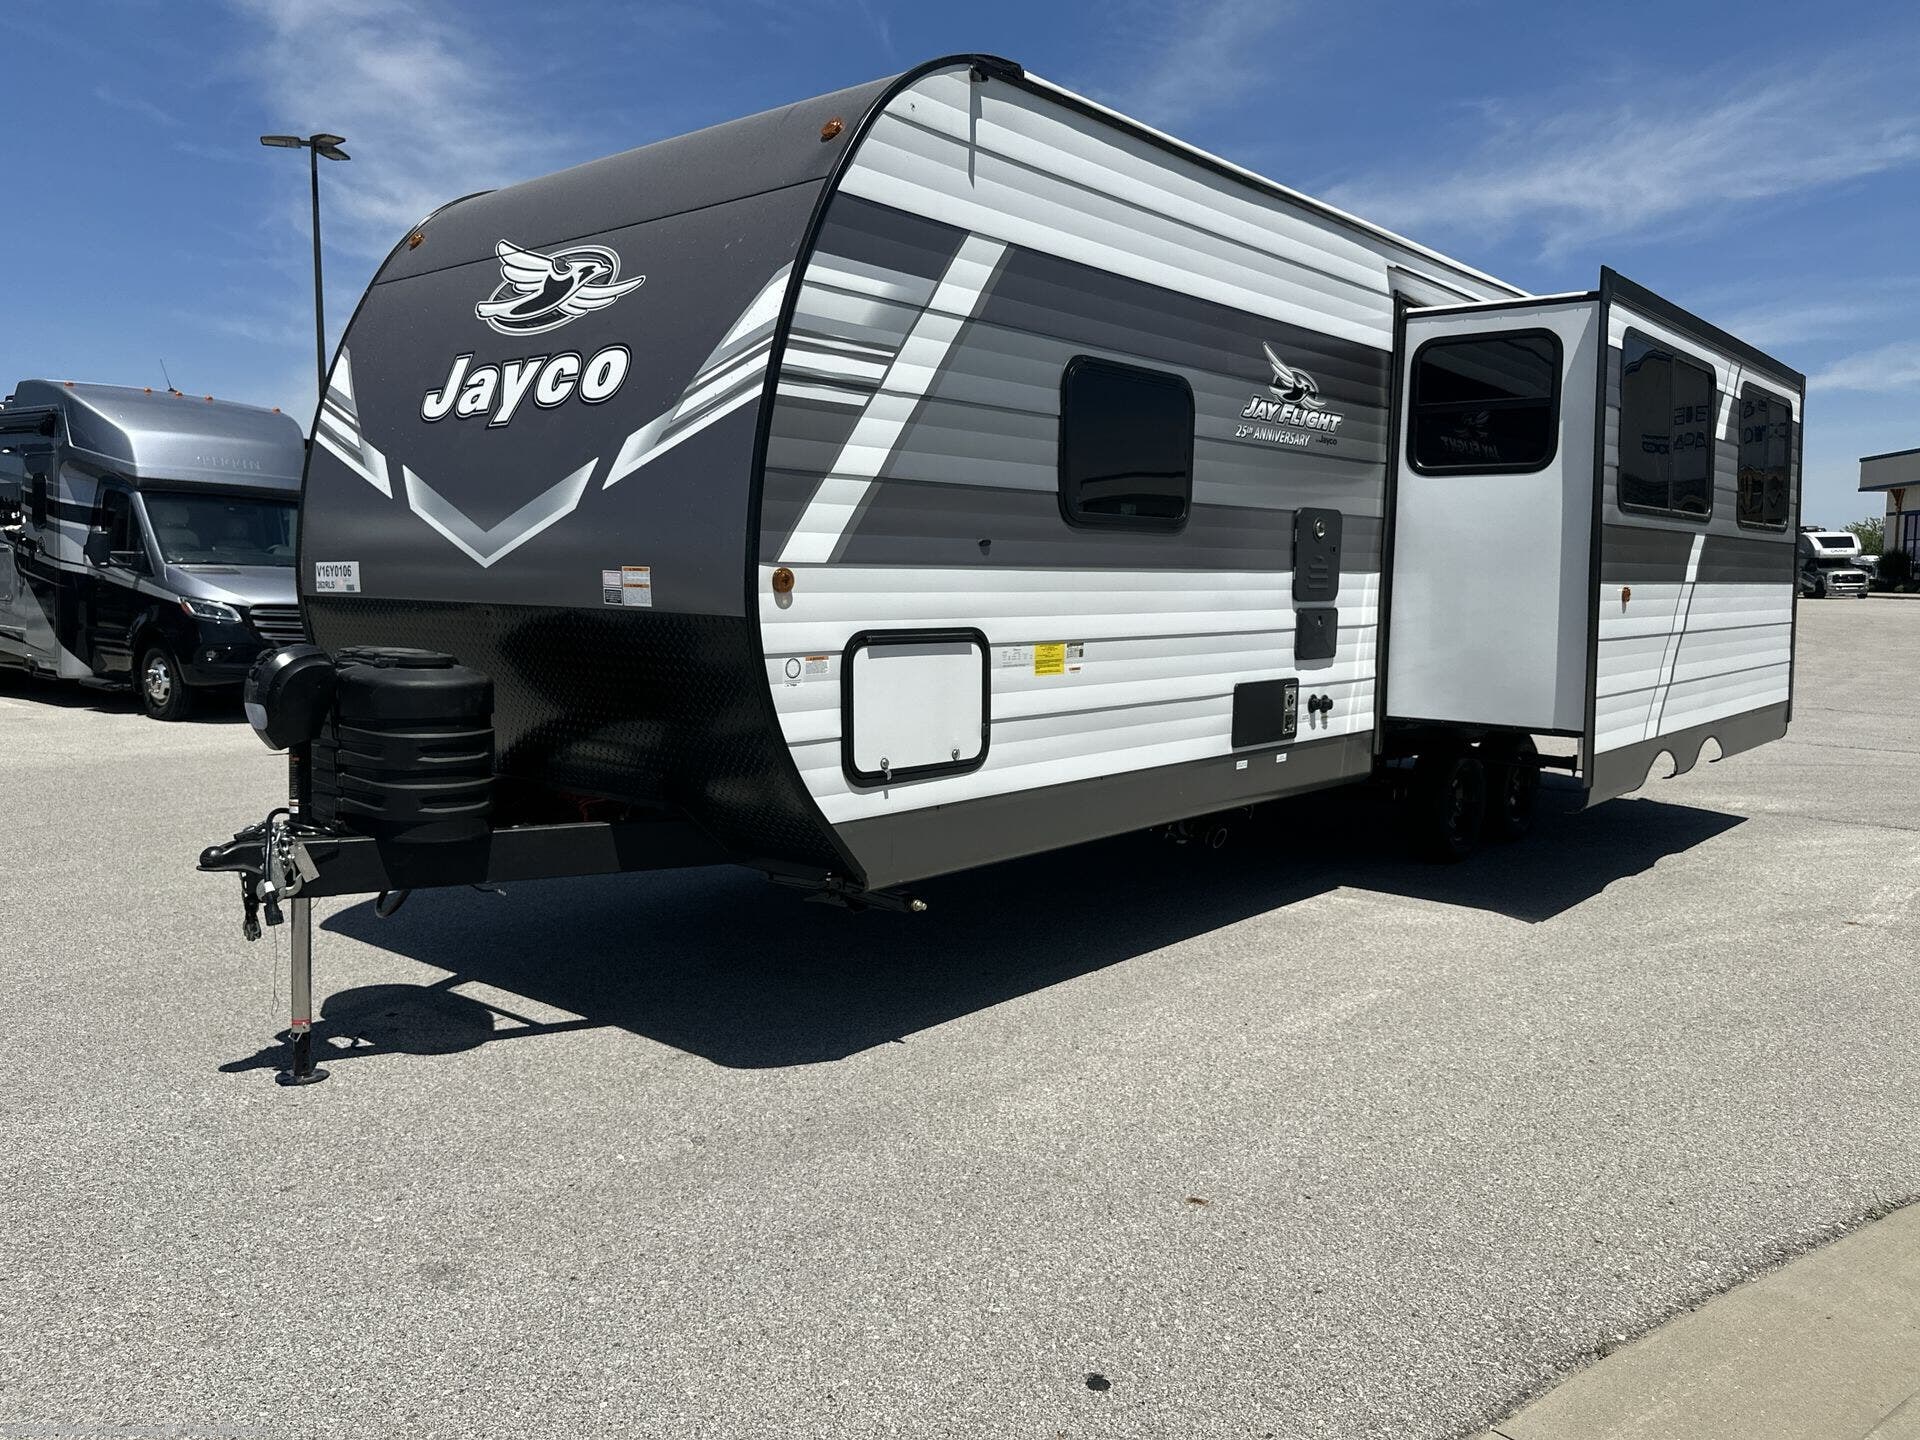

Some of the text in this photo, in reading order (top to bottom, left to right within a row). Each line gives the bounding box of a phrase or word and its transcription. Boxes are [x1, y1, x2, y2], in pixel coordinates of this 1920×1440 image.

[421, 344, 631, 427] Jayco
[1241, 395, 1342, 433] JAY FLIGHT
[1253, 427, 1311, 447] ANNIVERSARY
[316, 564, 352, 577] V16Y0106
